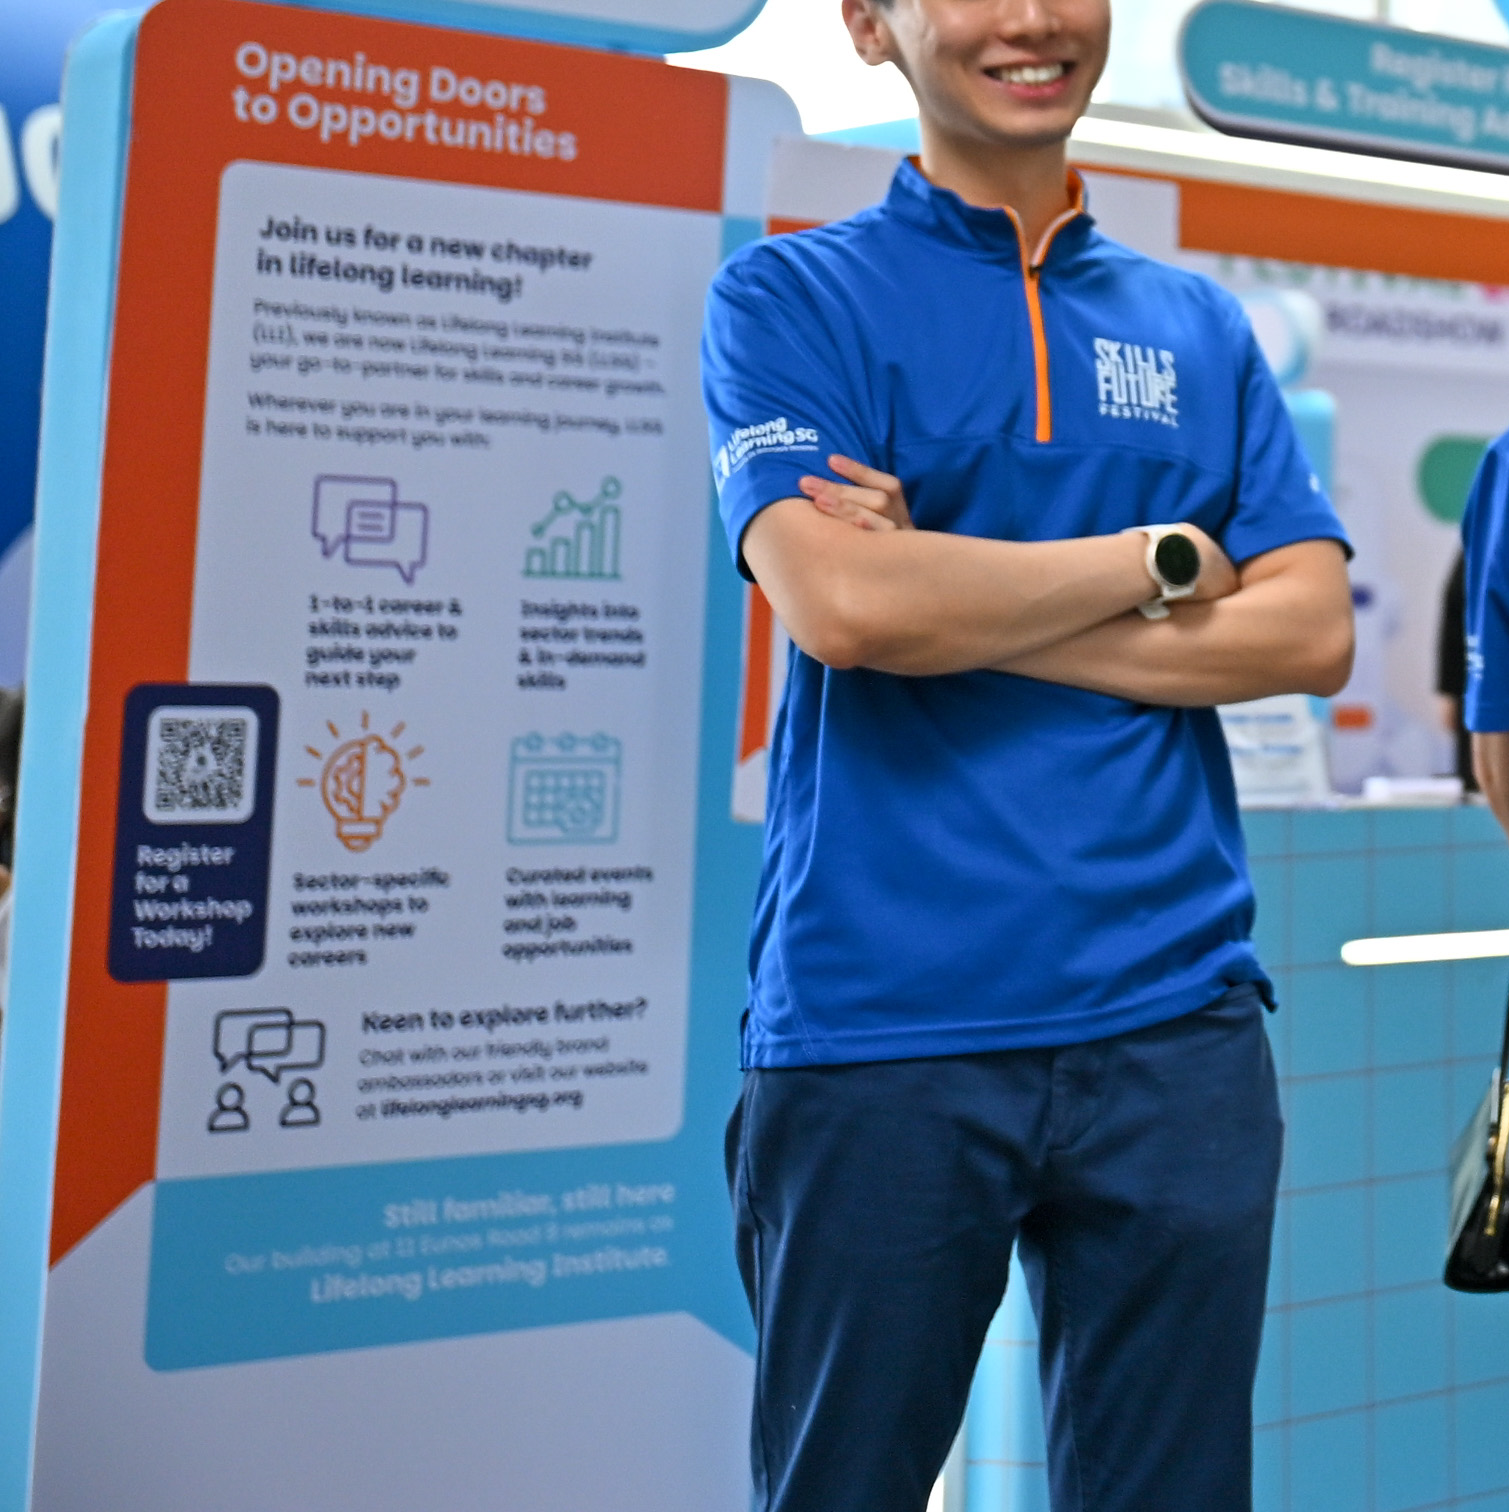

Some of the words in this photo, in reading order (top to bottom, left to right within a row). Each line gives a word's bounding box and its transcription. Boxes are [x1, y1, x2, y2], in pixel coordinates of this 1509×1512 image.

[235, 42, 419, 108] Opening
[429, 67, 545, 113] Doors
[1370, 42, 1498, 94] Register
[1219, 61, 1307, 108] Skills
[1315, 78, 1338, 111] &
[1347, 81, 1475, 143] Training
[232, 86, 277, 124] to
[288, 94, 575, 159] Opportunities
[259, 216, 318, 242] Join
[324, 227, 357, 247] us
[362, 225, 400, 250] for
[405, 234, 424, 254] a
[429, 237, 485, 258] new
[490, 242, 592, 271] chapter
[256, 248, 283, 274] in
[289, 253, 395, 292] lifelong
[401, 265, 522, 303] learning!
[1094, 338, 1175, 377] SKILLS
[1096, 357, 1178, 414] FUTURE
[1099, 402, 1179, 427] FESTIVAL
[378, 599, 443, 615] career
[308, 619, 361, 637] skills
[364, 622, 433, 639] advice
[436, 623, 458, 640] to
[305, 645, 365, 668] guide
[368, 648, 416, 669] your
[304, 670, 351, 687] next
[355, 671, 401, 691] step
[136, 842, 233, 874] Register
[134, 869, 170, 893] for
[171, 874, 189, 893] a
[133, 897, 252, 929] Workshop
[291, 897, 403, 916] workshops
[407, 896, 429, 913] to
[504, 891, 548, 909] with
[550, 890, 632, 917] learning
[132, 924, 212, 952] Today!
[289, 924, 368, 945] explore
[372, 923, 415, 938] new
[503, 916, 543, 934] and
[287, 949, 367, 967] careers
[502, 937, 632, 961] opportunities
[361, 1012, 424, 1032] Keen
[429, 1010, 455, 1029] to
[458, 1006, 548, 1031] explore
[553, 997, 647, 1022] further?
[383, 1199, 437, 1228] Still
